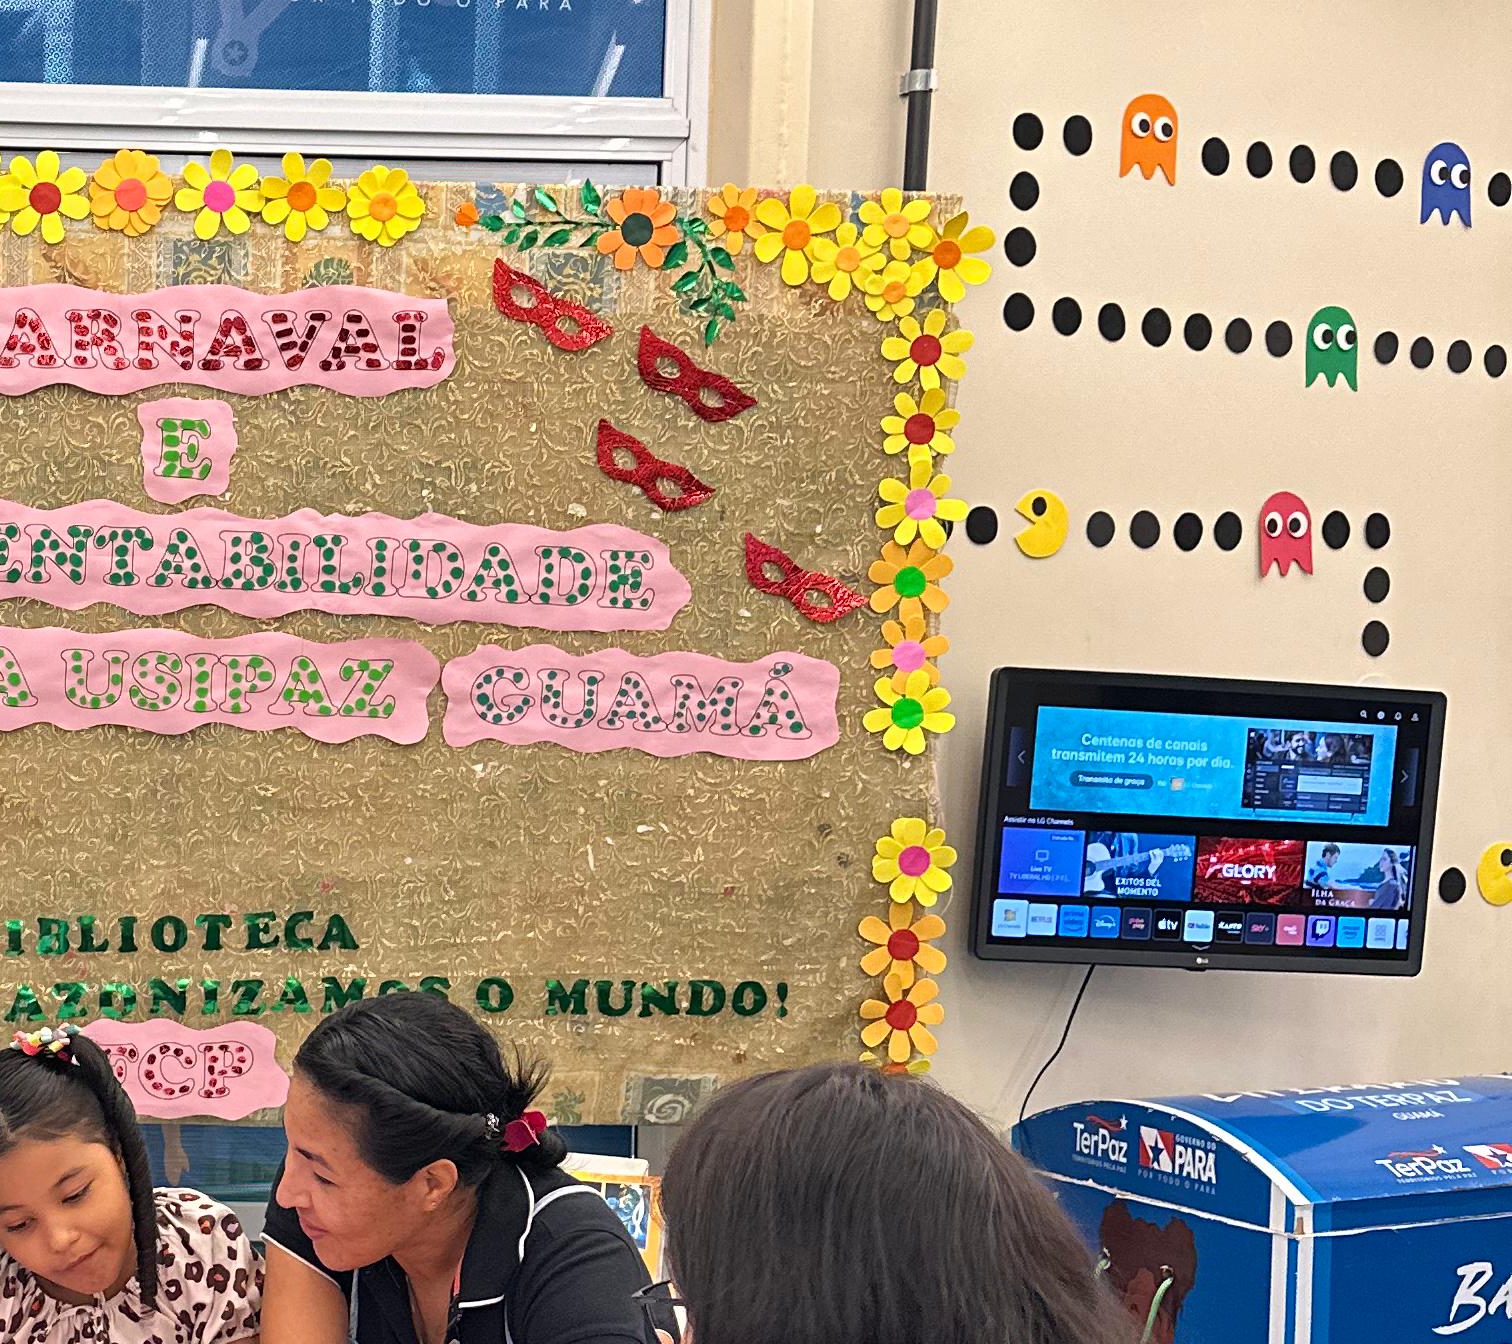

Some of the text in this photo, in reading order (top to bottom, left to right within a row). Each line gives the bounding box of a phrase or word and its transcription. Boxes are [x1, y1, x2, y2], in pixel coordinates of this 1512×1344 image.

[155, 418, 213, 480] E
[61, 648, 396, 718] USIPAZ
[469, 661, 813, 740] GUAMÁ
[1081, 733, 1209, 752] Centenas de canais
[1051, 748, 1235, 769] transmitem 24 horas por dia.
[1222, 863, 1276, 880] GLORY
[475, 975, 515, 1014] O
[544, 977, 790, 1018] MUNDO!
[1295, 1089, 1473, 1113] DO TERPAZ
[1073, 1121, 1128, 1164] TerPaz
[1175, 1133, 1205, 1149] GOVERNO
[1375, 1155, 1471, 1179] TerPaz
